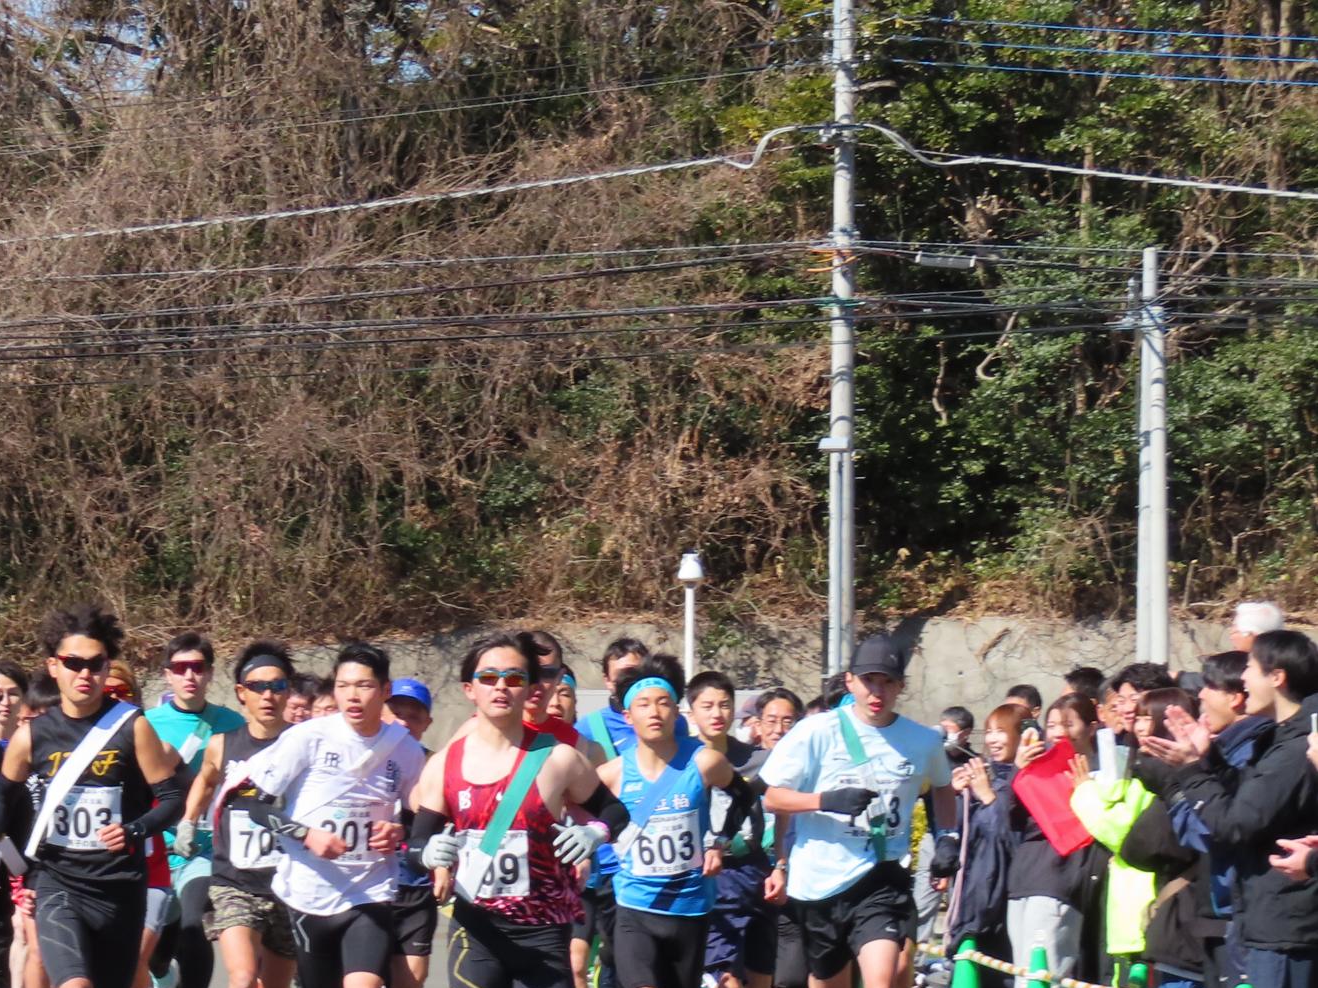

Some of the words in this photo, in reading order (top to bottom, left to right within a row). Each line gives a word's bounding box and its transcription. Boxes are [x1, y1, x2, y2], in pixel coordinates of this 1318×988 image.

[54, 804, 112, 839] 303
[239, 830, 282, 858] 70
[637, 831, 695, 866] 603
